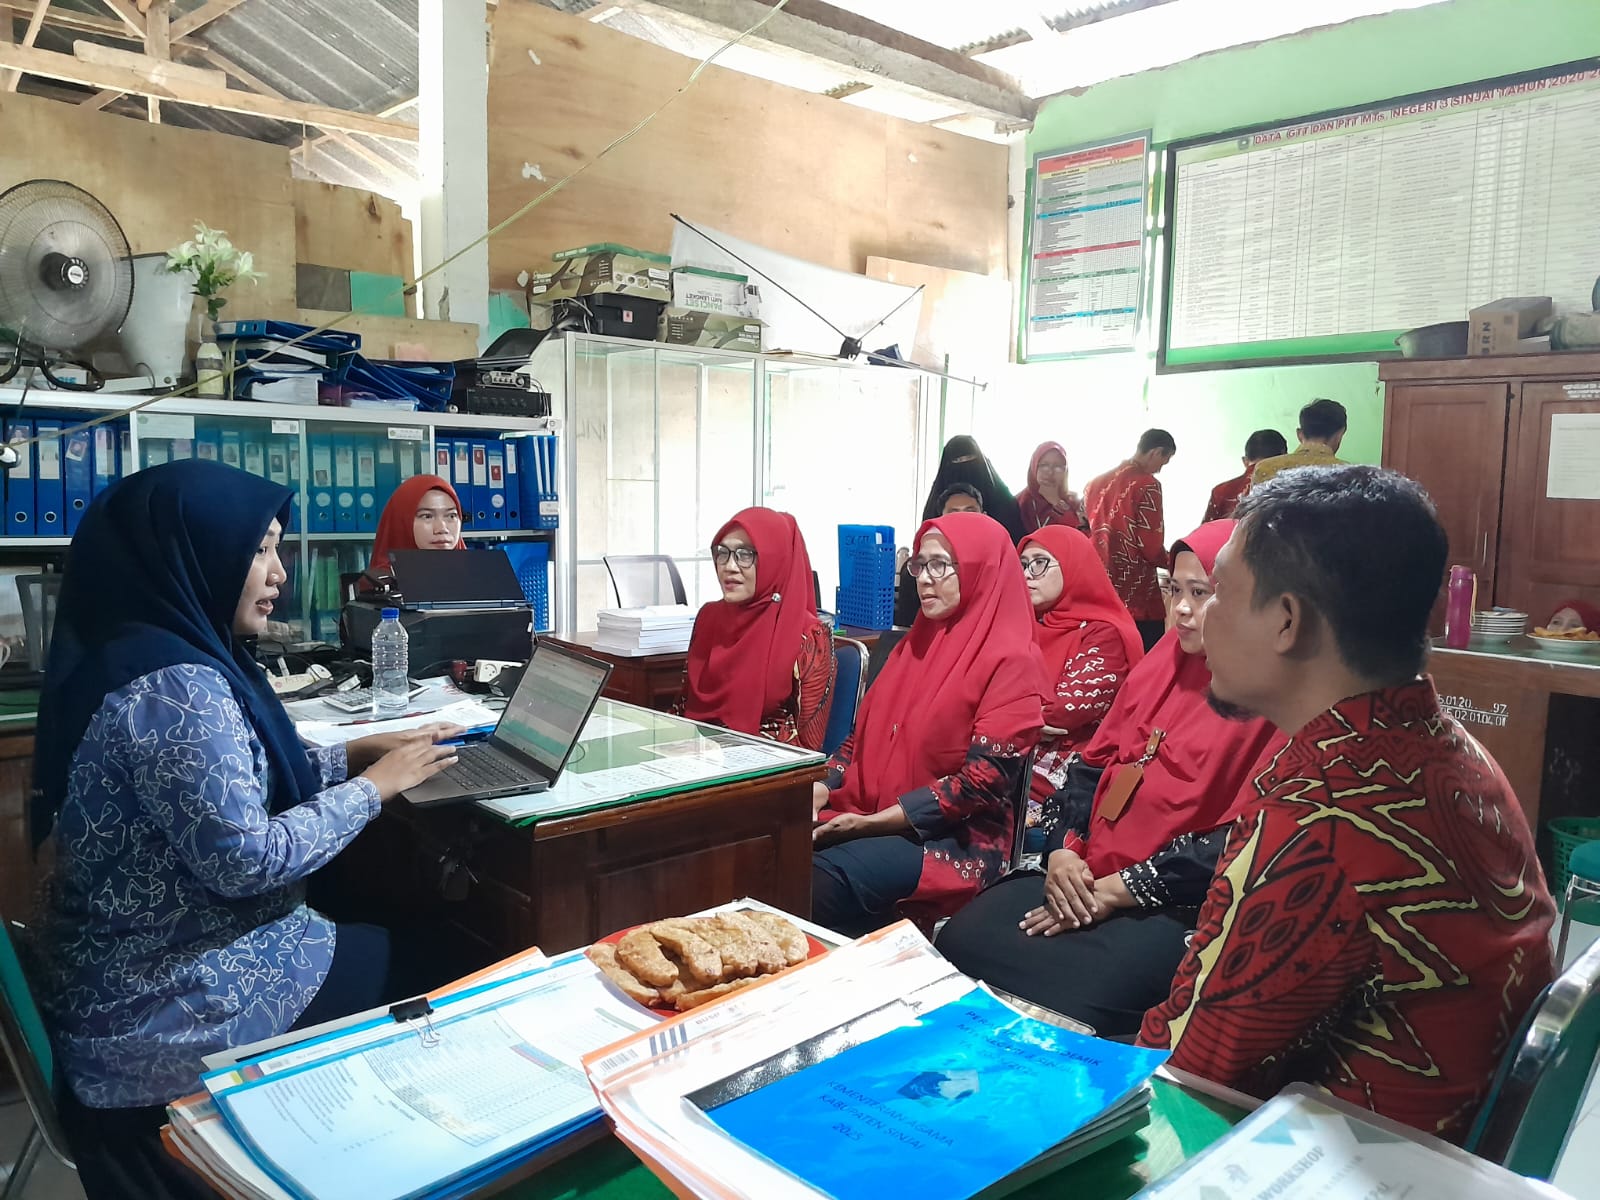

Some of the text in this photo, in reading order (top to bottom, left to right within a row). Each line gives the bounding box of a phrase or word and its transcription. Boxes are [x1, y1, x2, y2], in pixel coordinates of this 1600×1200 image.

[1254, 132, 1282, 145] DATA
[1287, 126, 1310, 139] GTT
[1311, 121, 1335, 133] DAN
[1337, 117, 1359, 129] PTT
[1391, 101, 1438, 119] NEGERI
[1451, 90, 1495, 107] SINJAI
[1498, 79, 1546, 98] TAHUN
[1551, 72, 1585, 88] 2020
[819, 1093, 925, 1150] KABUPATEN SINJAI
[827, 1080, 954, 1147] KEMENTERIAN AGAMA
